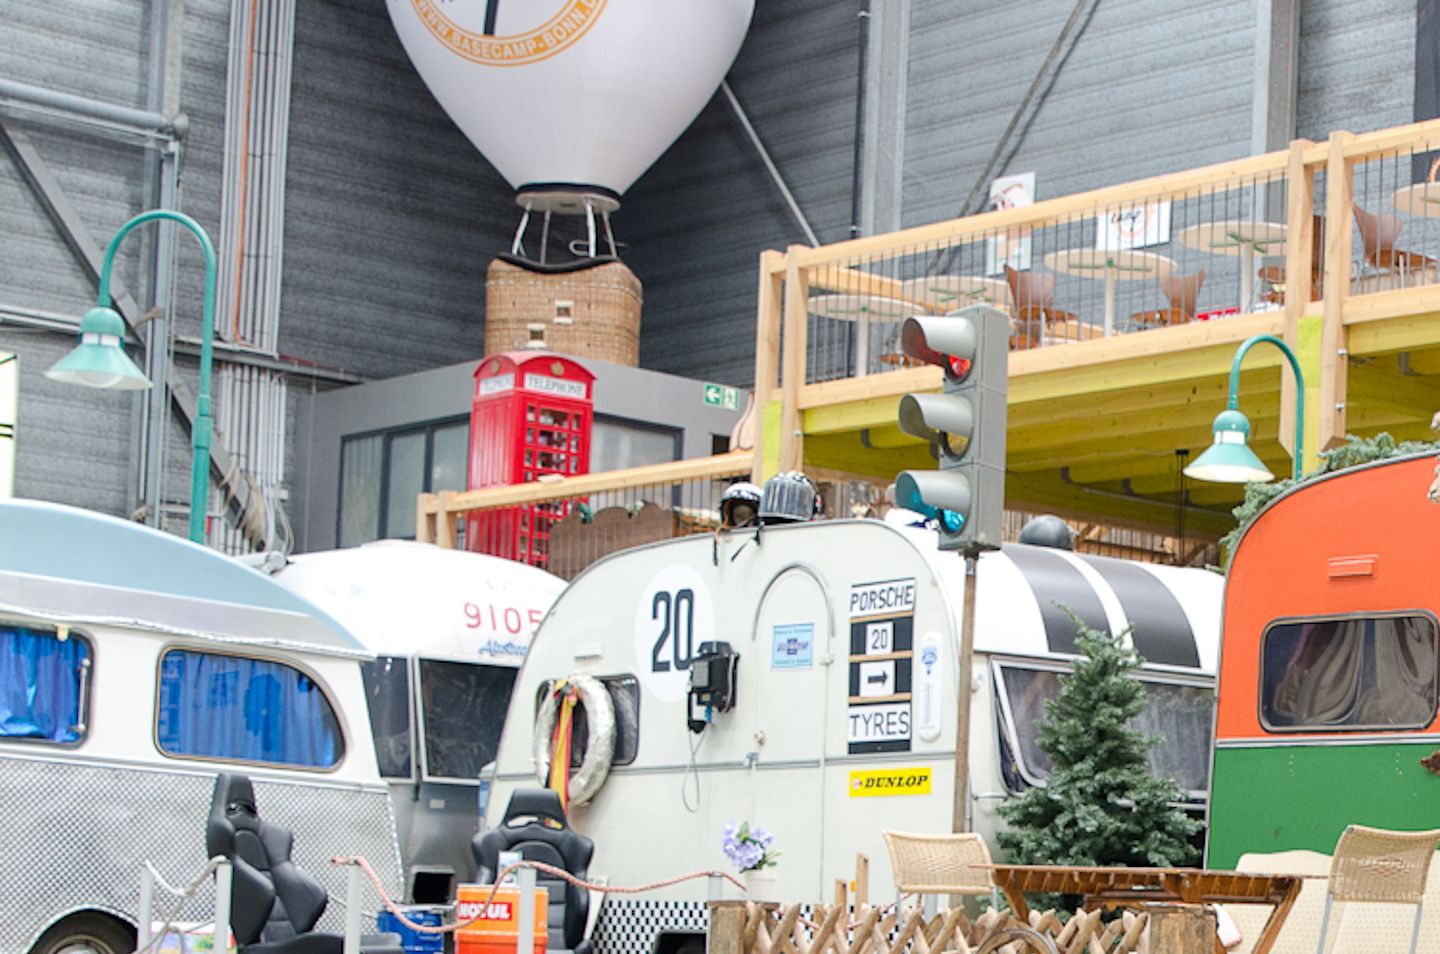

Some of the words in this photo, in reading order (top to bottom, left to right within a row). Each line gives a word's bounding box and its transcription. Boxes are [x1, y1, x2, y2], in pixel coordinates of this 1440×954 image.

[528, 375, 584, 396] TELEPHONE
[850, 584, 914, 612] PORSCHE
[652, 588, 694, 672] 20
[871, 628, 888, 650] 20
[850, 711, 910, 737] TYRES
[864, 775, 928, 789] DUNLOP
